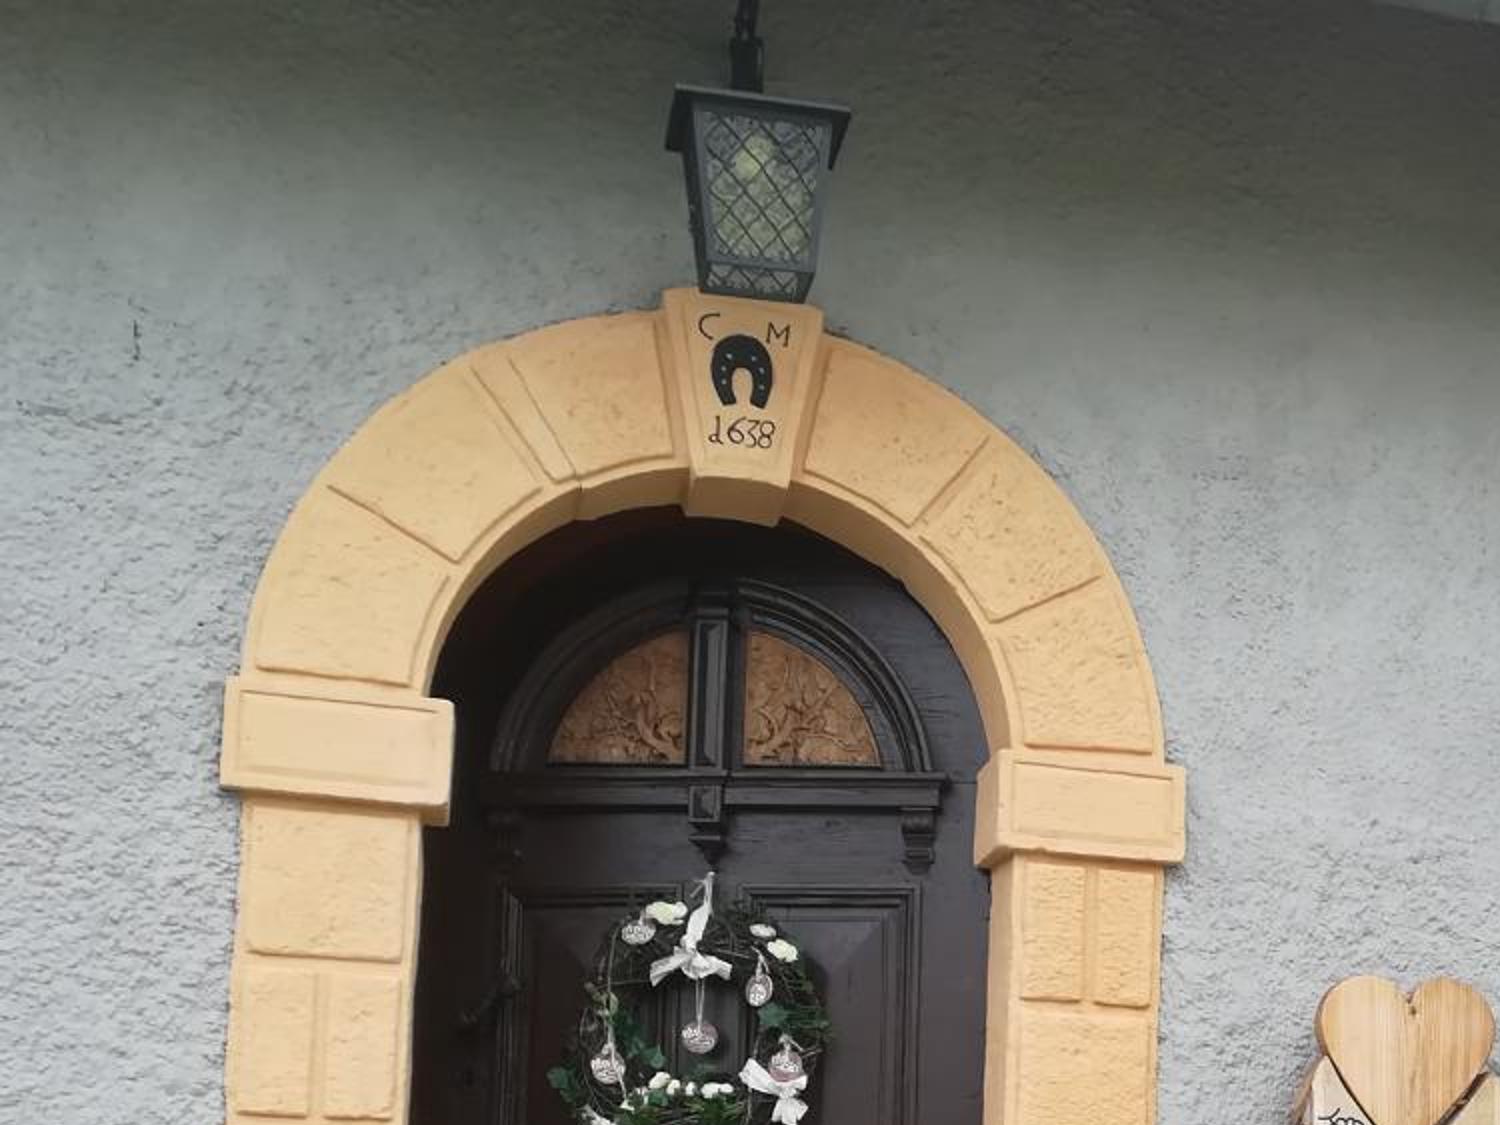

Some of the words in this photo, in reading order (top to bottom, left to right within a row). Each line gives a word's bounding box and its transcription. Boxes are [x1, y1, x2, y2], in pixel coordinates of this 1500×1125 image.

[698, 313, 721, 341] C
[765, 321, 791, 348] M
[708, 415, 776, 449] 1638
